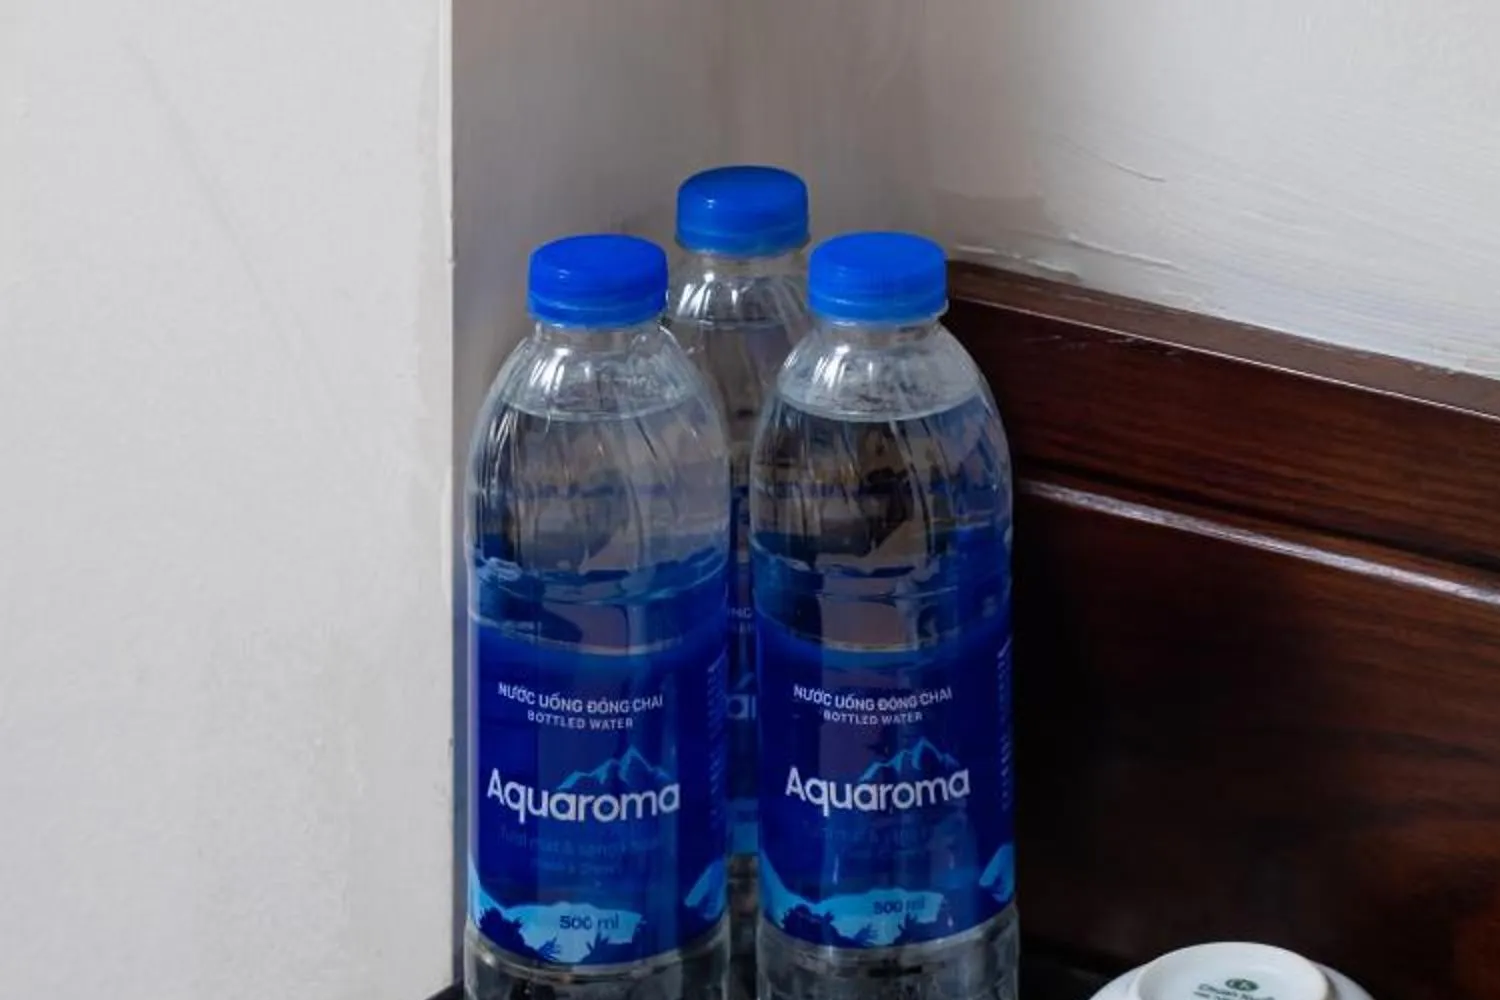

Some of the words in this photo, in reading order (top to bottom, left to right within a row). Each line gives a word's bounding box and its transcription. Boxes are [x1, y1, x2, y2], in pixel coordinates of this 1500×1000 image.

[633, 695, 663, 711] CHAI
[919, 687, 953, 706] CHAI
[527, 710, 585, 729] BOTTLED
[589, 717, 633, 730] WATER
[823, 709, 878, 725] BOTTLED
[881, 711, 923, 725] WATER
[487, 768, 680, 824] Aquaroma
[785, 766, 971, 817] Aquaroma
[559, 915, 592, 929] 500
